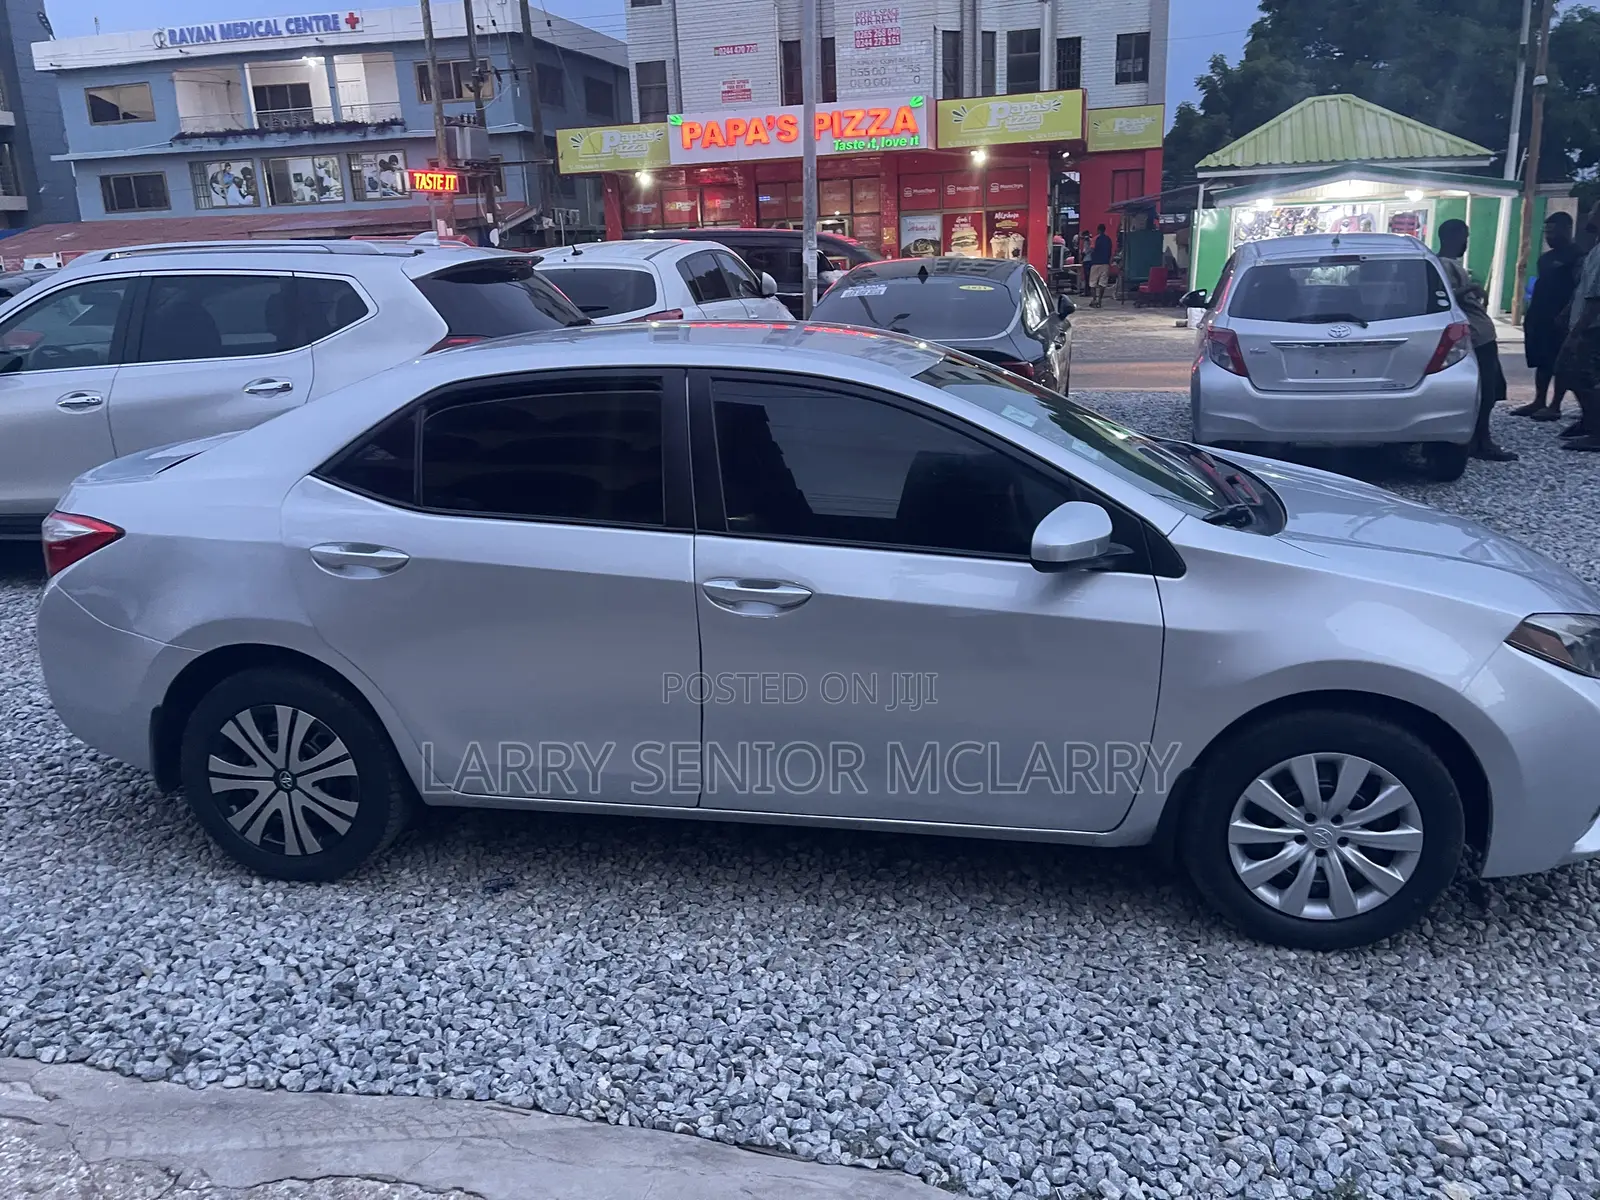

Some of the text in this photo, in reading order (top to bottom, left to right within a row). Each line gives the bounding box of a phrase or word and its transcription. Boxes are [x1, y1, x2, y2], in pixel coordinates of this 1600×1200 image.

[855, 16, 873, 26] FOR
[168, 14, 341, 45] RAYAN MEDICAL CENTRE
[855, 39, 873, 48] 0244
[681, 105, 920, 150] PAPA'S PIZZA
[833, 138, 865, 151] Taste
[880, 137, 906, 148] love
[909, 135, 920, 147] it
[413, 173, 457, 190] TASTE IT
